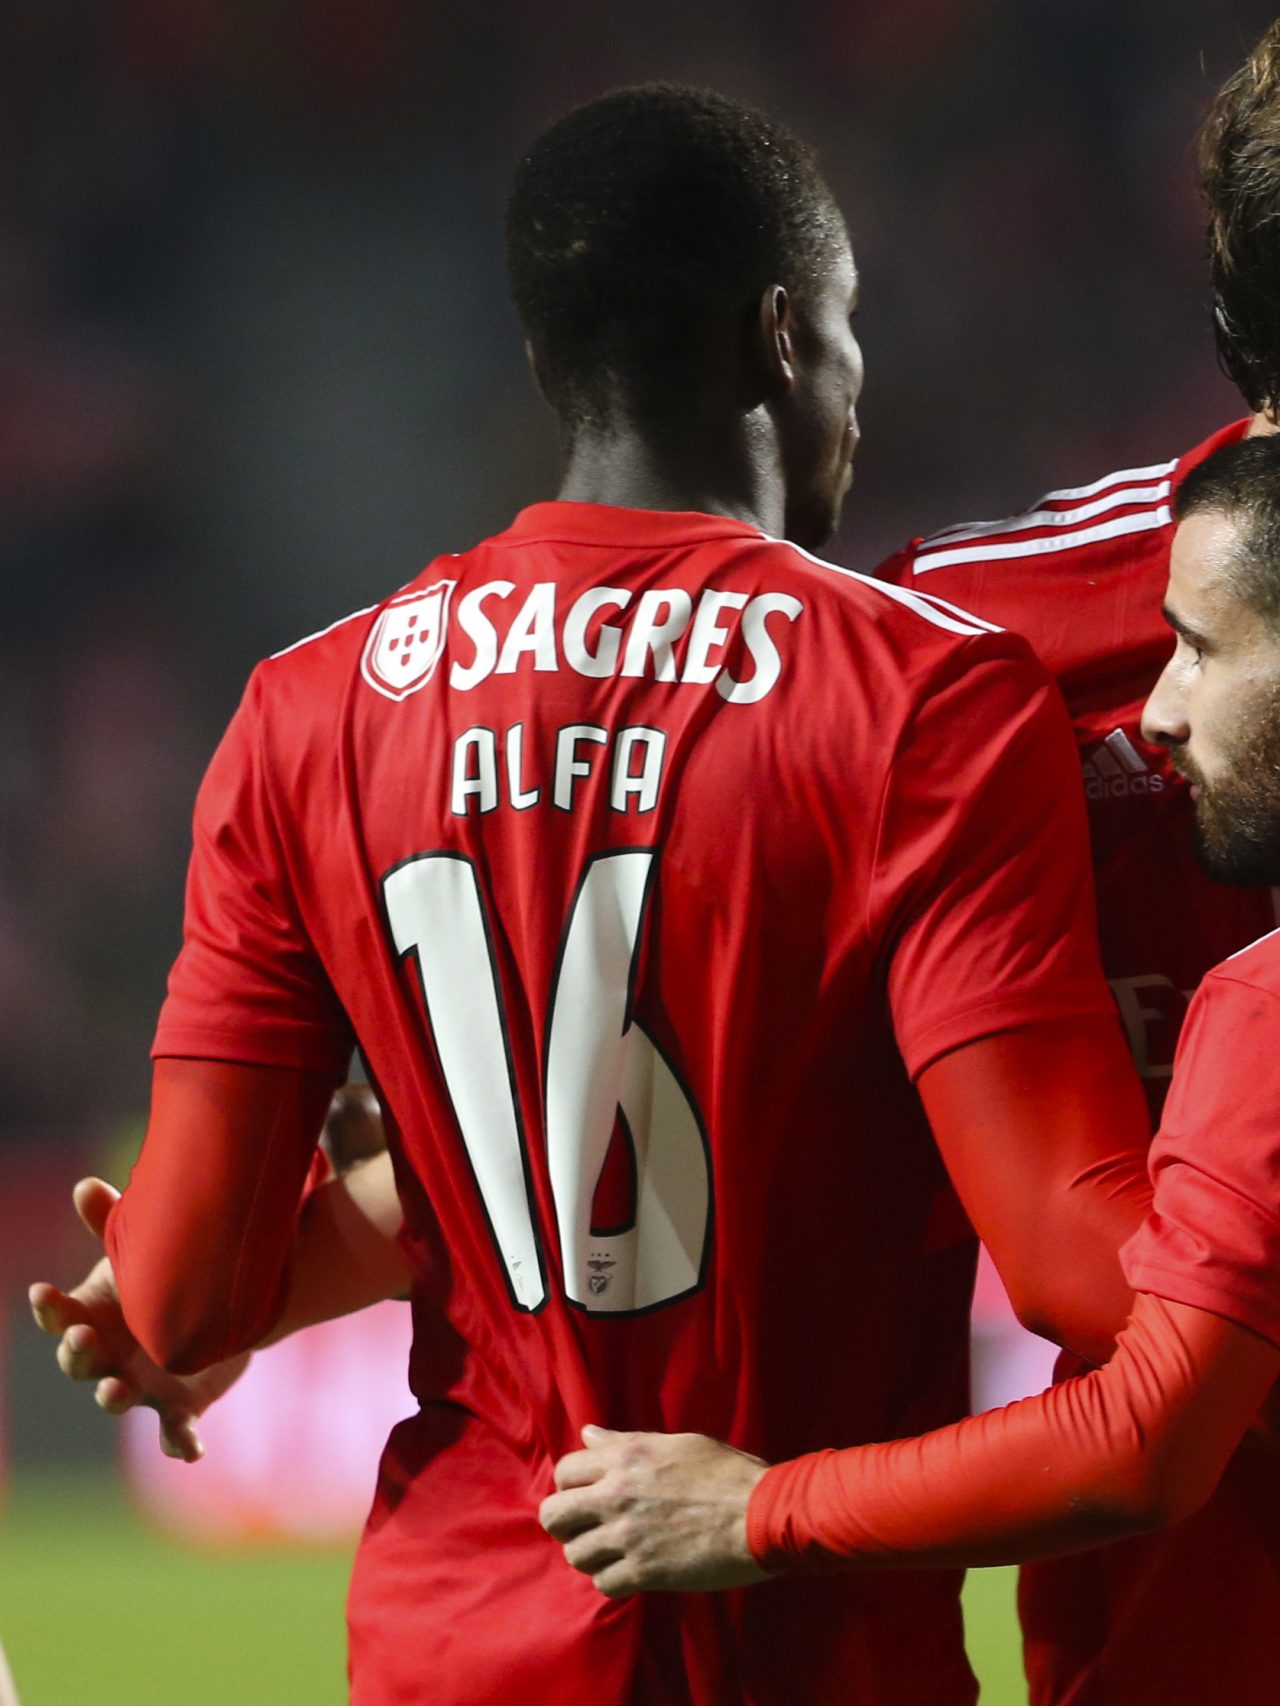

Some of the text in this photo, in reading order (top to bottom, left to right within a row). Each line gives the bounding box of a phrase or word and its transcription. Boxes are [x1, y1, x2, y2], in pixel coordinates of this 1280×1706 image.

[449, 580, 804, 704] SAGRES
[451, 721, 668, 817] ALFA
[1085, 773, 1165, 800] didas
[382, 846, 715, 1319] 16
